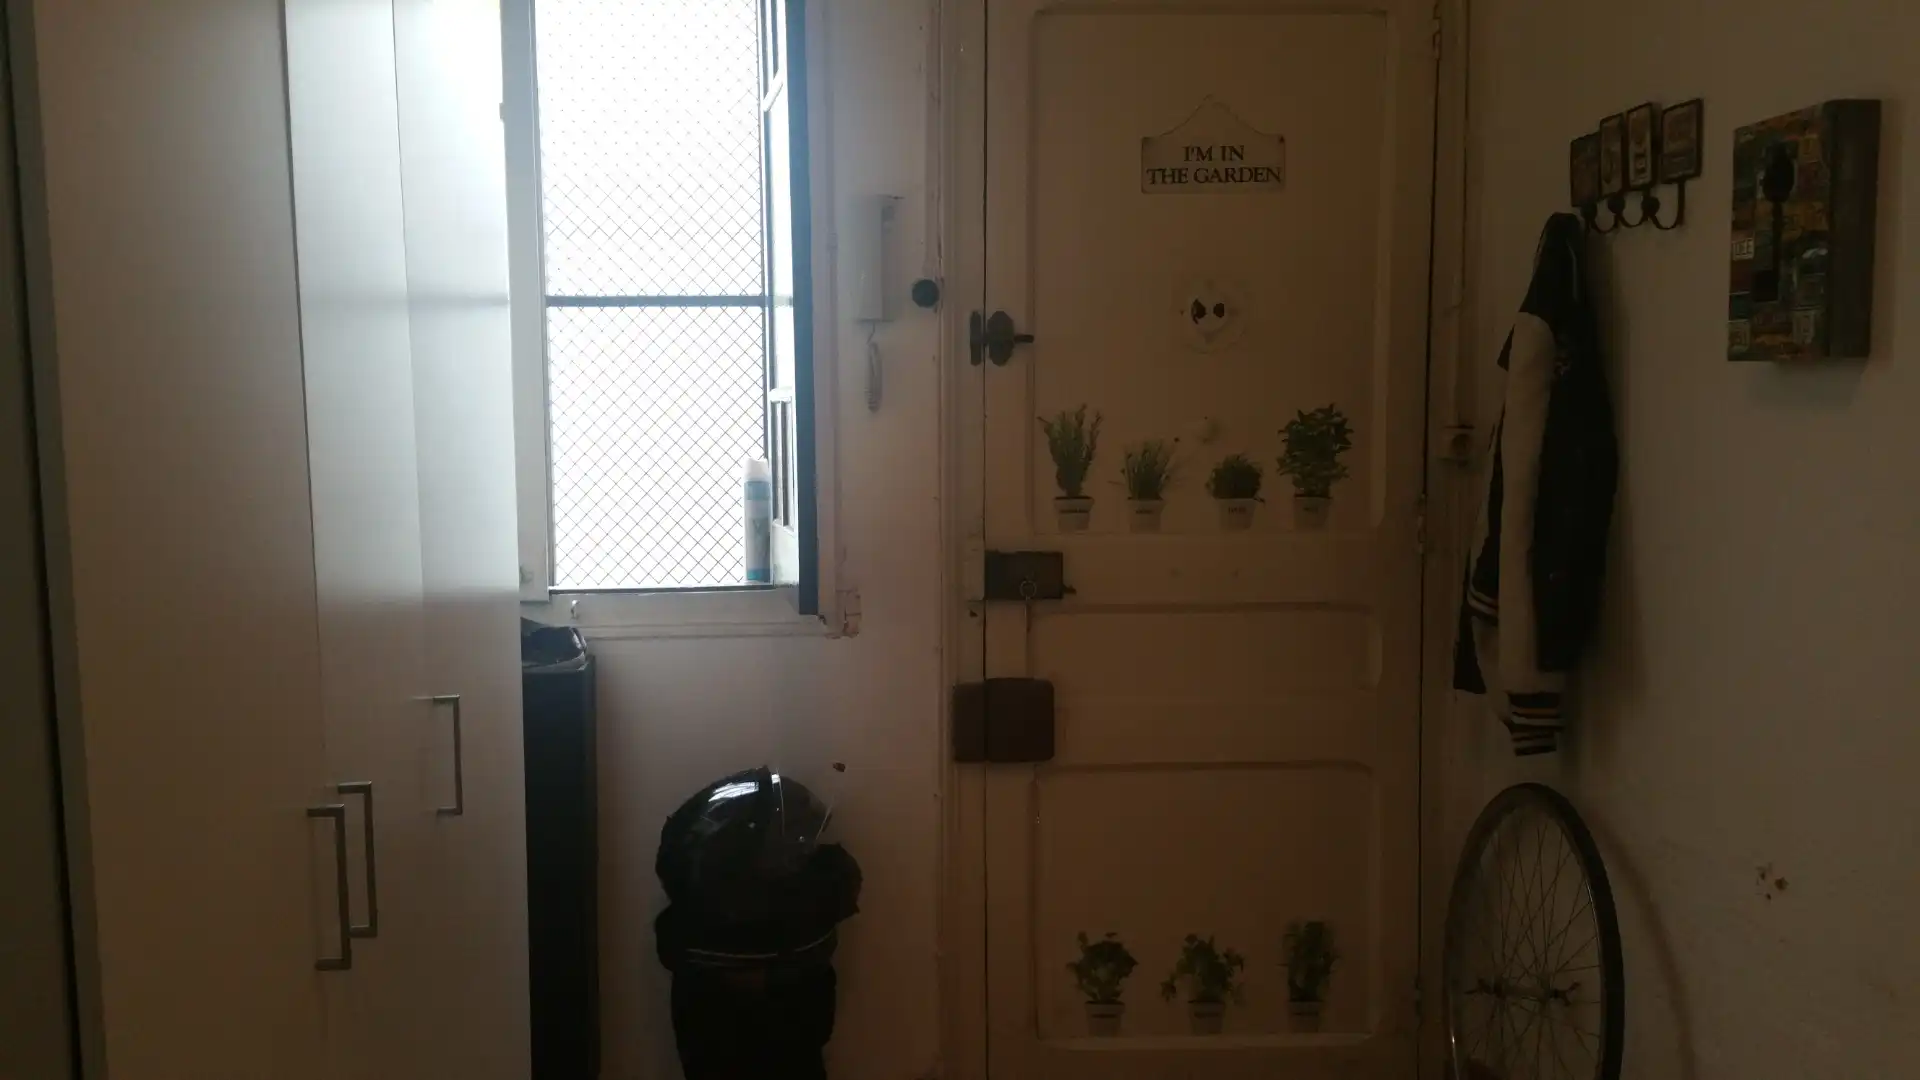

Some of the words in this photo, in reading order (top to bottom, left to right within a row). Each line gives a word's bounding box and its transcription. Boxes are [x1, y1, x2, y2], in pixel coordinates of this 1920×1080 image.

[1182, 145, 1213, 162] I'M
[1219, 144, 1246, 162] IN
[1146, 167, 1188, 185] THE
[1193, 166, 1284, 184] GARDEN
